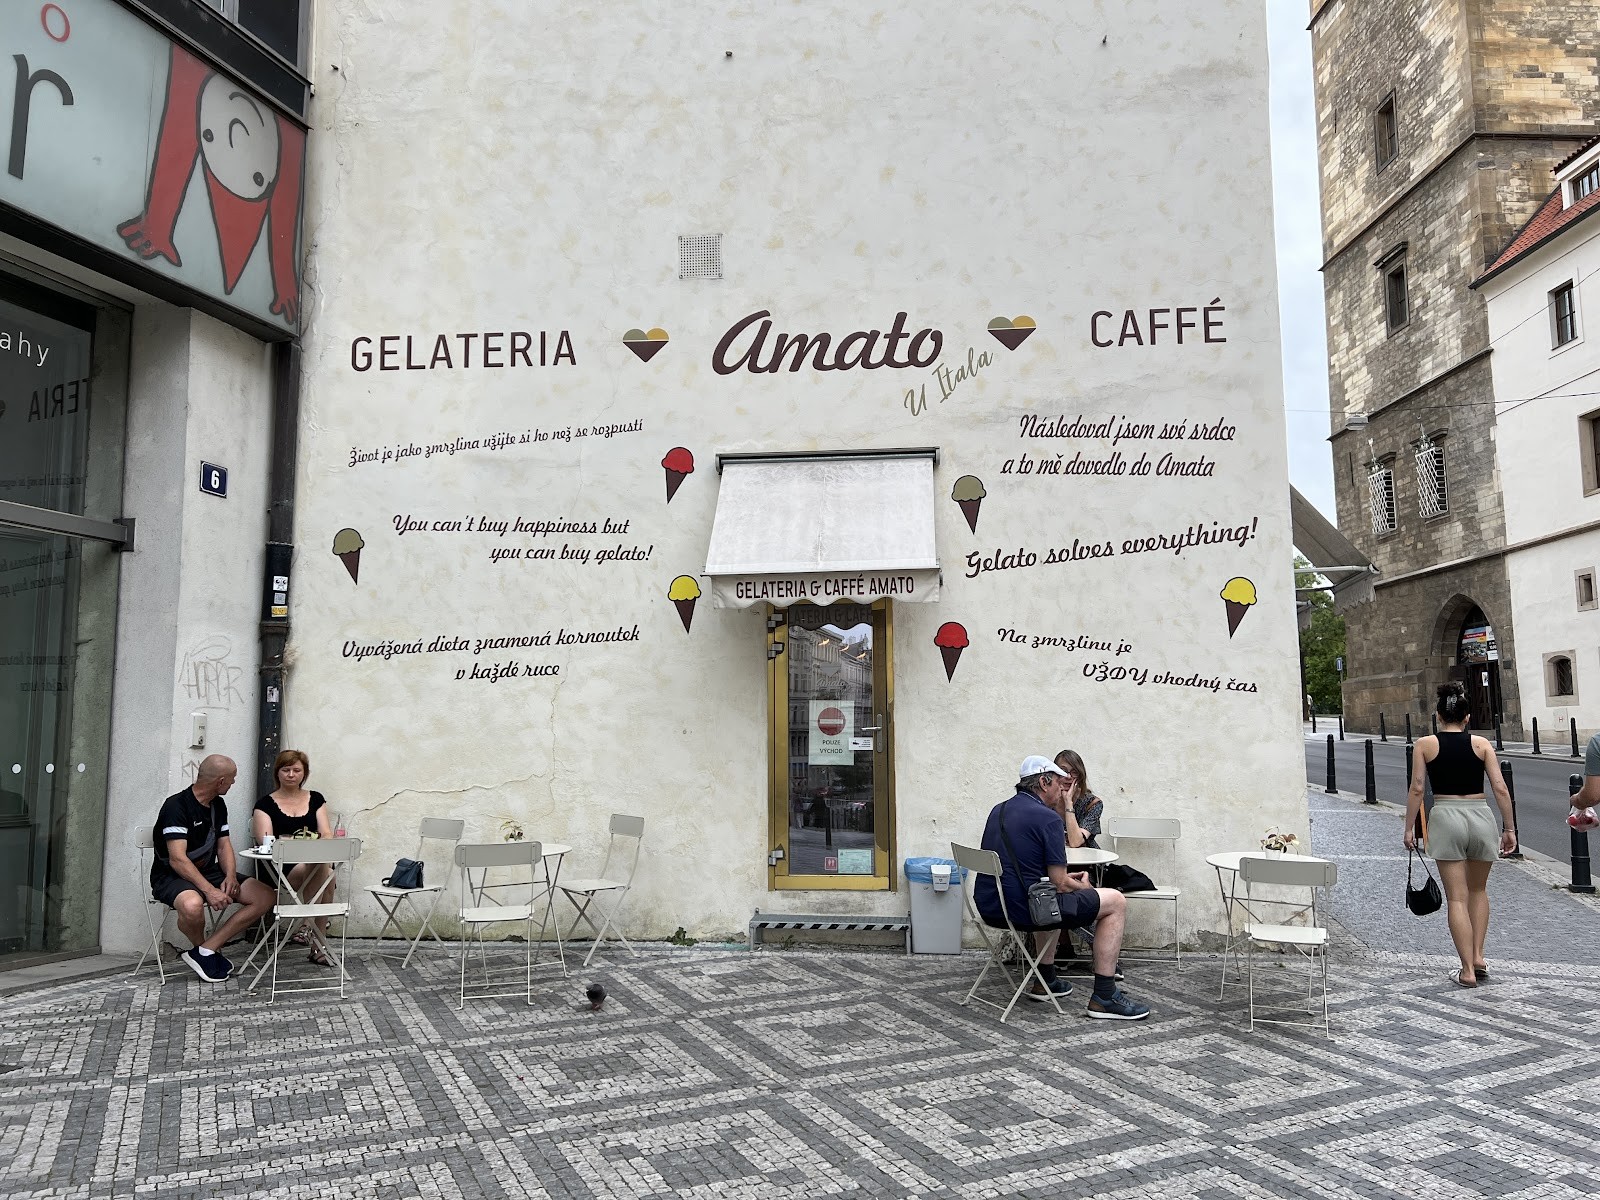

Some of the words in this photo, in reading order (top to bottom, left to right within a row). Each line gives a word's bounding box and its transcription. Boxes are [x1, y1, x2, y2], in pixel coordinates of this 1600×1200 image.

[1091, 297, 1226, 347] CAFFÉ
[0, 331, 49, 367] ahy
[352, 331, 576, 372] GELATERIA
[712, 310, 944, 375] Amato
[904, 383, 927, 416] U
[932, 347, 993, 404] Itala
[348, 447, 379, 467] Život
[382, 446, 392, 463] je
[395, 443, 421, 462] jako
[425, 437, 479, 458] zmrzlina
[482, 432, 515, 450] užijte
[518, 430, 530, 443] si
[533, 429, 548, 442] ho
[552, 426, 571, 442] než
[574, 428, 588, 437] se
[591, 419, 643, 438] rozpustí
[1020, 414, 1115, 438] Následoval
[1113, 416, 1155, 446] jsem
[1157, 419, 1187, 439] své
[1188, 417, 1235, 440] srdce
[211, 470, 220, 489] 6
[1000, 459, 1014, 474] a
[1016, 453, 1033, 474] to
[1036, 454, 1064, 474] mě
[1063, 451, 1126, 475] dovedlo
[1129, 452, 1151, 475] do
[1156, 452, 1215, 476] Amata
[393, 515, 428, 535] You
[431, 515, 474, 531] can't
[477, 516, 508, 537] buy
[511, 517, 597, 537] happiness
[601, 518, 630, 534] but
[489, 546, 521, 564] you
[524, 547, 555, 560] can
[558, 544, 591, 565] buy
[594, 544, 653, 565] gelato!
[966, 548, 1036, 578] Gelato
[1043, 539, 1114, 564] solves
[1120, 517, 1258, 555] everything!
[736, 580, 806, 598] GELATERIA
[811, 580, 821, 596] &
[825, 573, 864, 595] CAFFÉ
[869, 576, 914, 594] AMATO
[342, 638, 423, 662] Vyvážená
[426, 635, 470, 652] dieta
[474, 631, 551, 655] znamená
[555, 625, 639, 645] kornoutek
[998, 628, 1027, 643] Na
[1031, 635, 1111, 651] zmrzlinu
[1116, 639, 1132, 656] je
[454, 670, 465, 680] v
[469, 661, 519, 683] každé
[522, 665, 559, 676] ruce
[1083, 662, 1148, 685] VŽDY
[1152, 671, 1221, 693] vhodný
[1225, 678, 1257, 692] čas
